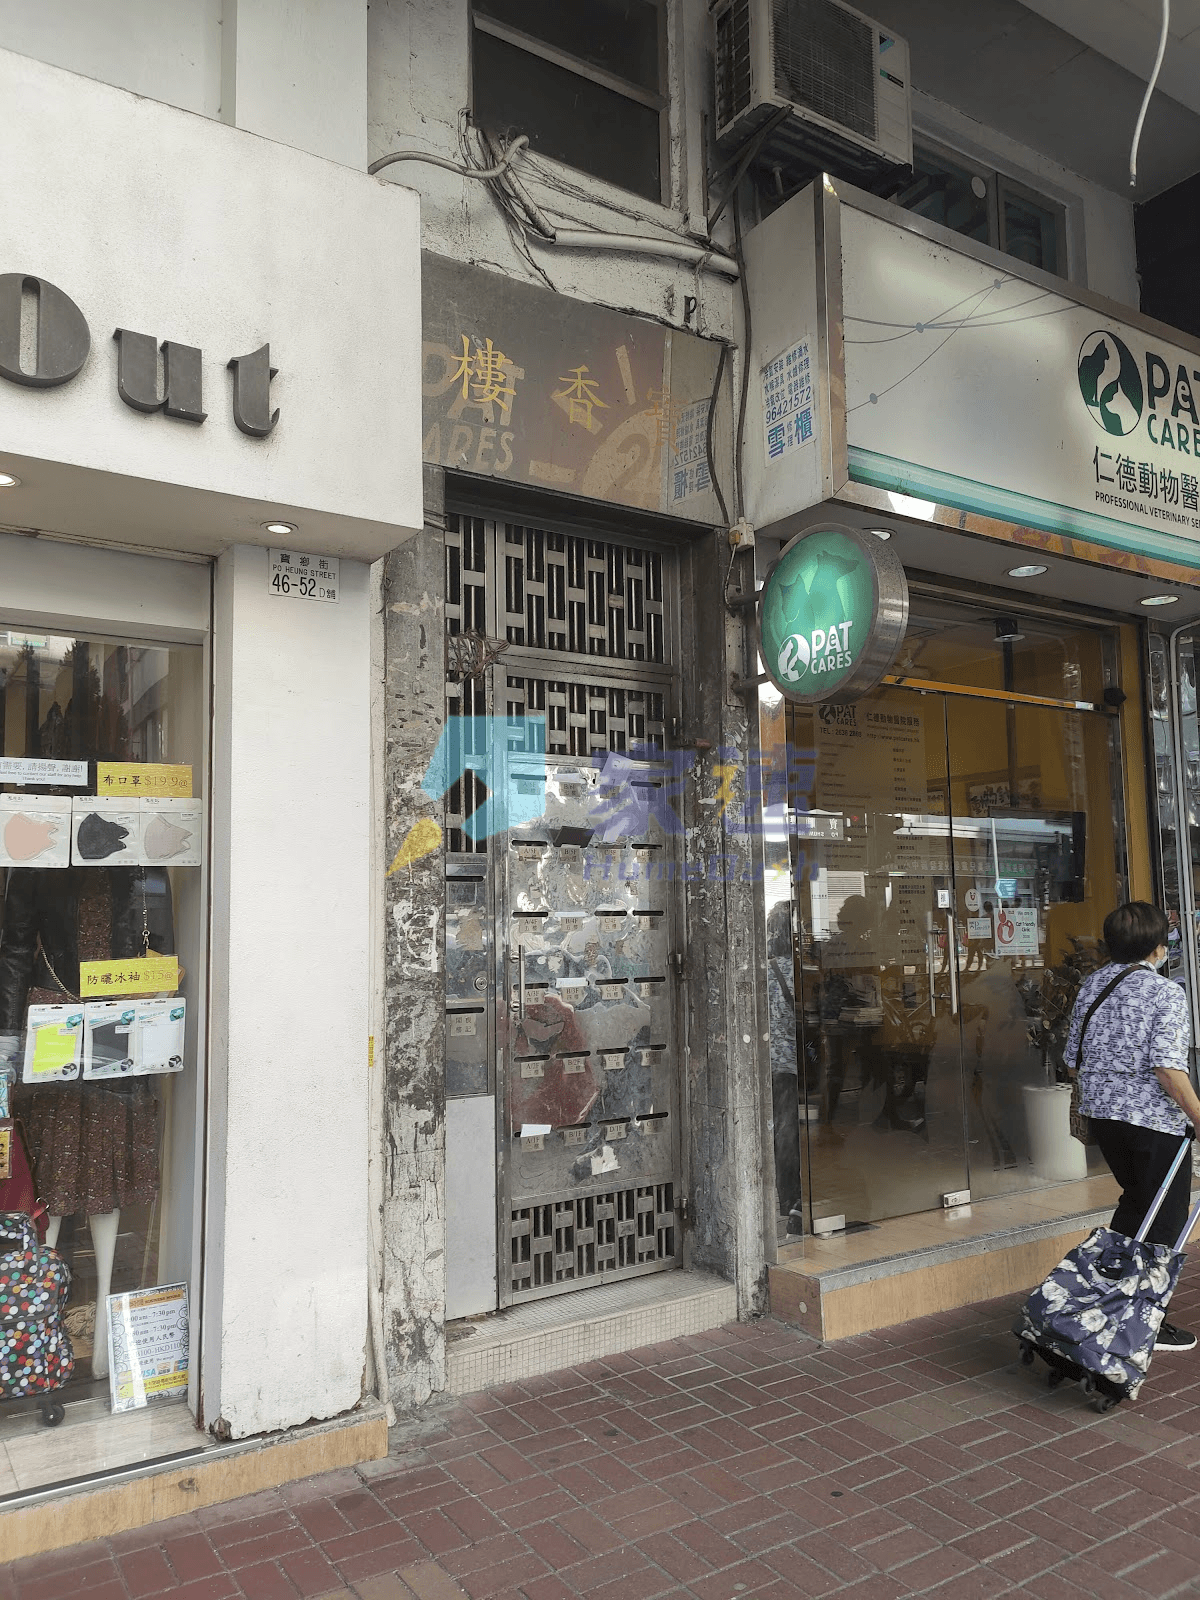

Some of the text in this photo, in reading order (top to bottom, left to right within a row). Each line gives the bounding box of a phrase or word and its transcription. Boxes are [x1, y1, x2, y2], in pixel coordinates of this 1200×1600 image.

[765, 385, 812, 425] 96421572
[1092, 445, 1200, 512] 仁德動物醫
[1095, 490, 1149, 515] PROFESSIONAL
[1149, 505, 1190, 528] VETERINARY
[272, 563, 336, 580] PO HEUNG STREET
[272, 573, 317, 597] 46-52
[811, 620, 853, 659] PAT
[810, 650, 852, 675] CARES
[609, 1125, 622, 1133] D/1F
